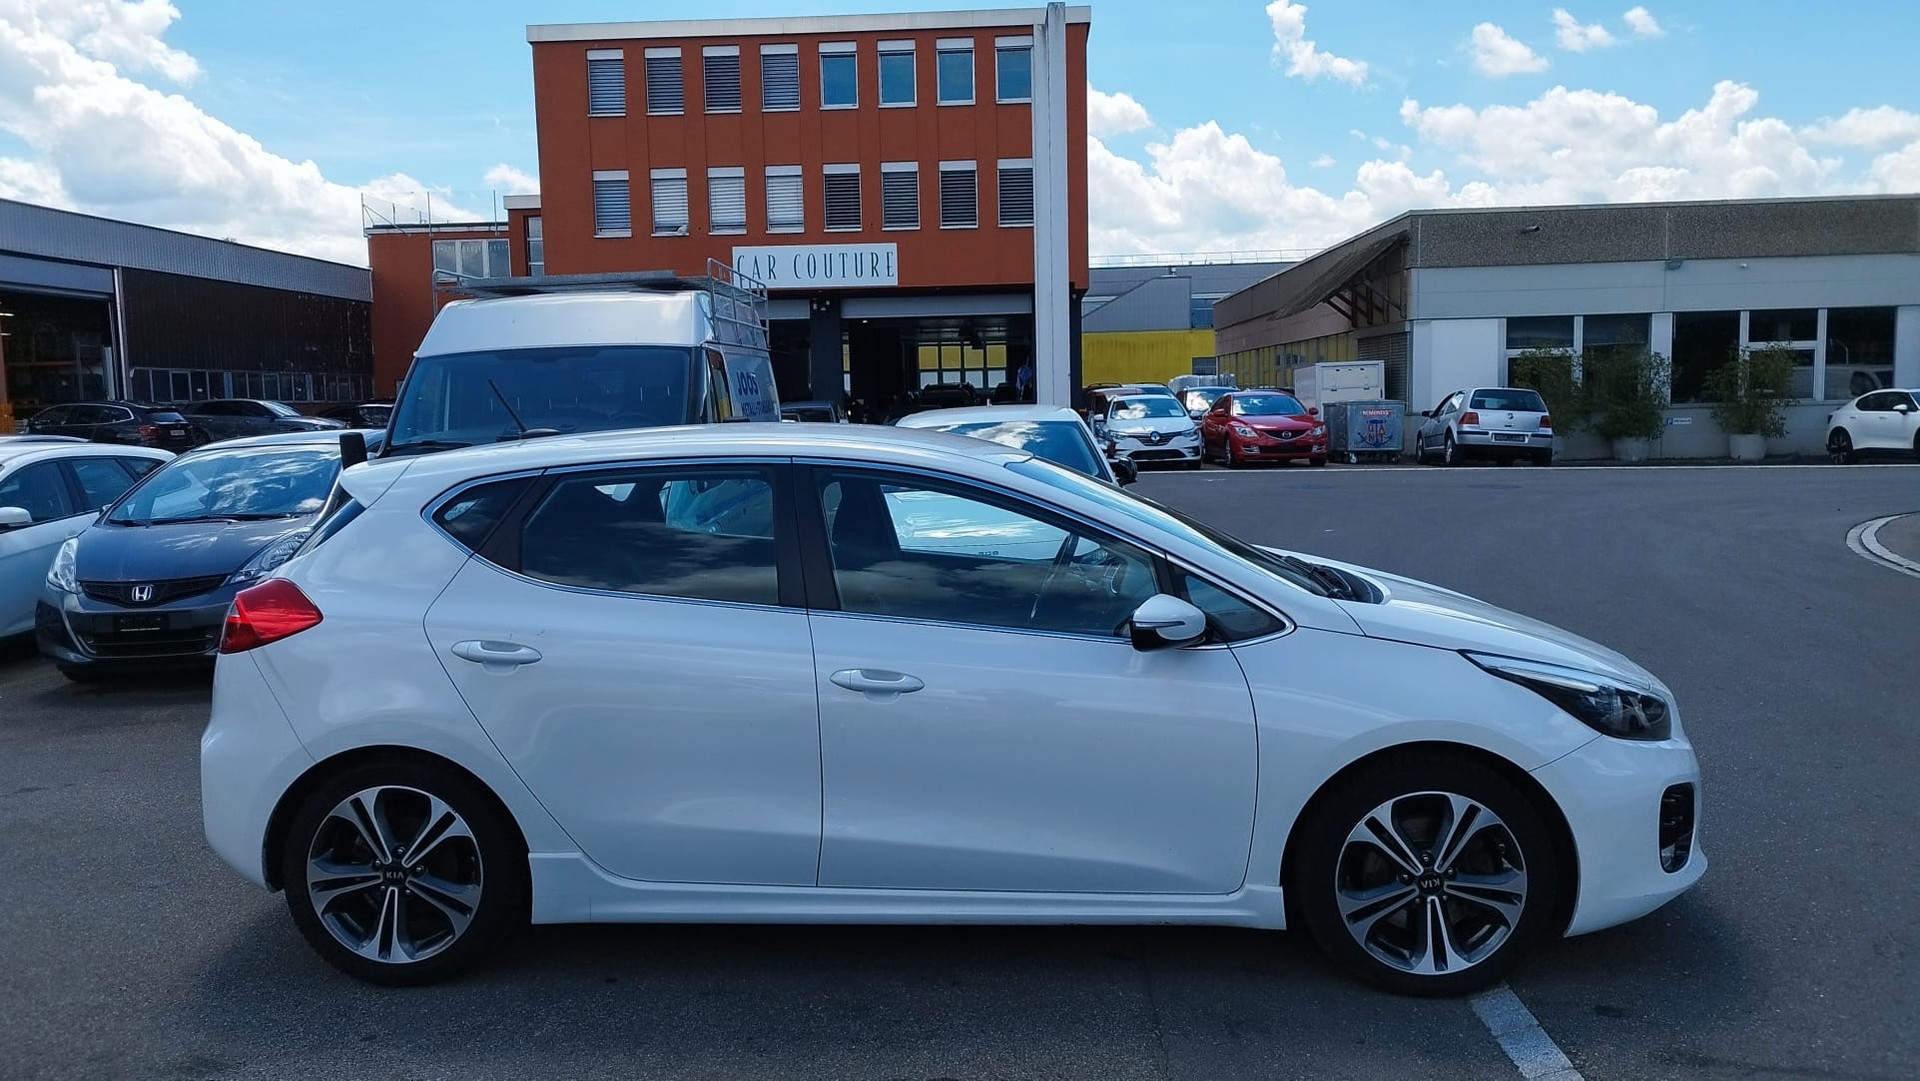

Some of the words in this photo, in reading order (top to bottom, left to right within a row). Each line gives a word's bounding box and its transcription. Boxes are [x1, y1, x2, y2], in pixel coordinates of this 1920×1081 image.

[737, 254, 777, 280] CAR
[793, 251, 895, 280] COUTURE
[386, 871, 405, 879] KIA
[1420, 878, 1440, 888] KIA
